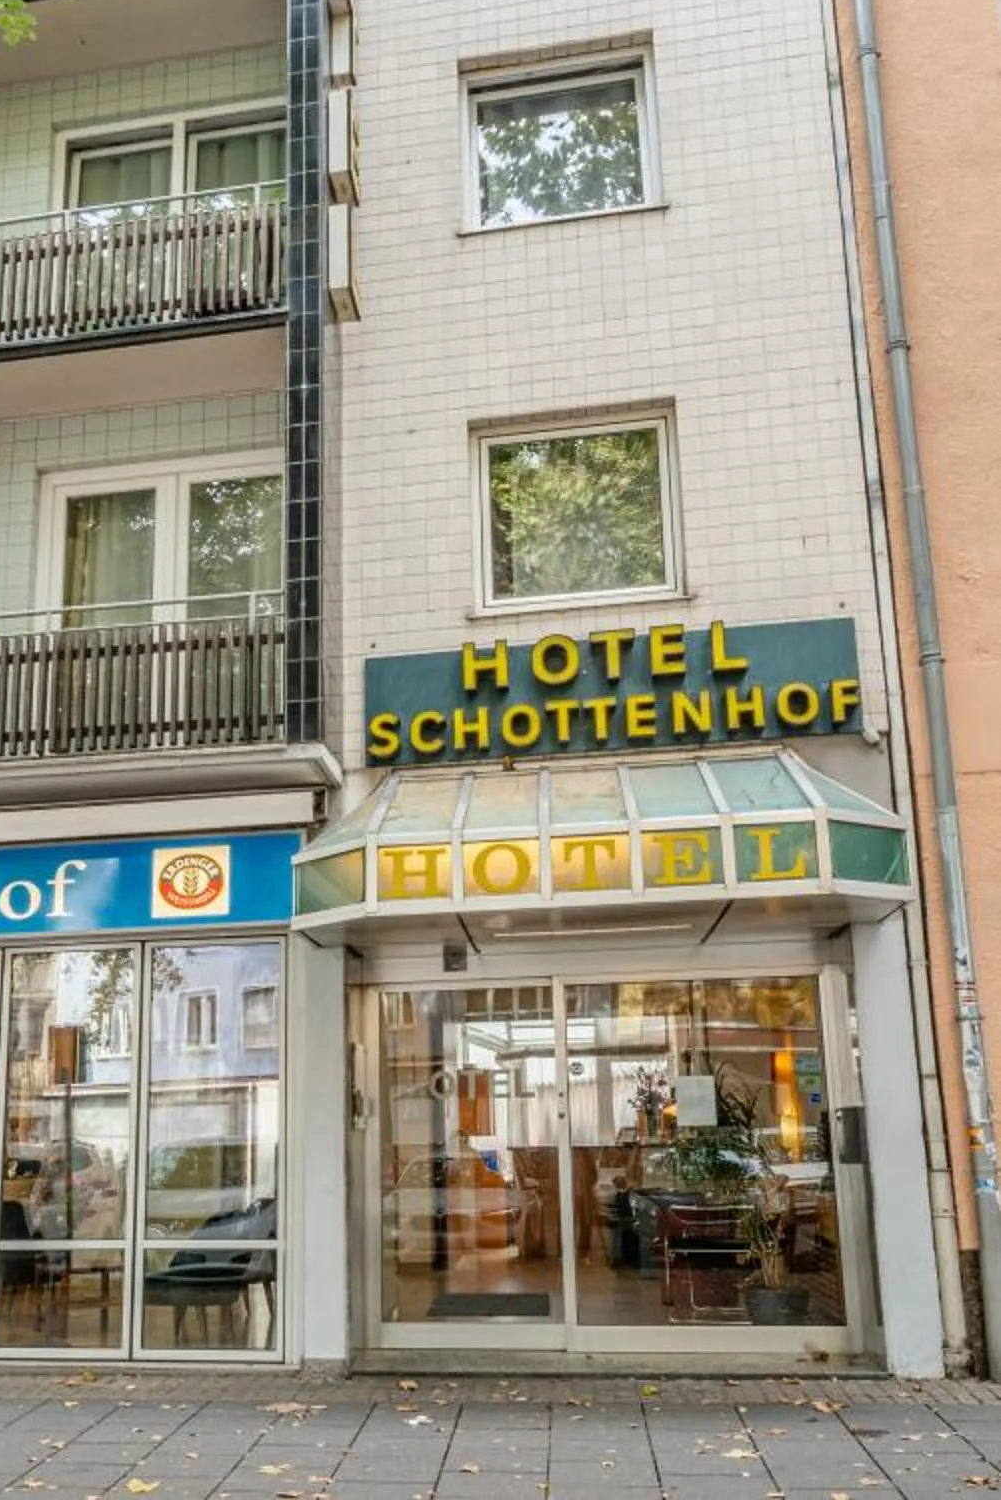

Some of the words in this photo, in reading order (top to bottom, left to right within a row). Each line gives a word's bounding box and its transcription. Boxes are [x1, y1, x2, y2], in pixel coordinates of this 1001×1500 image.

[461, 619, 749, 693] HOTEL
[366, 678, 862, 759] SCHOTTENHOF
[382, 827, 806, 899] HOTEL
